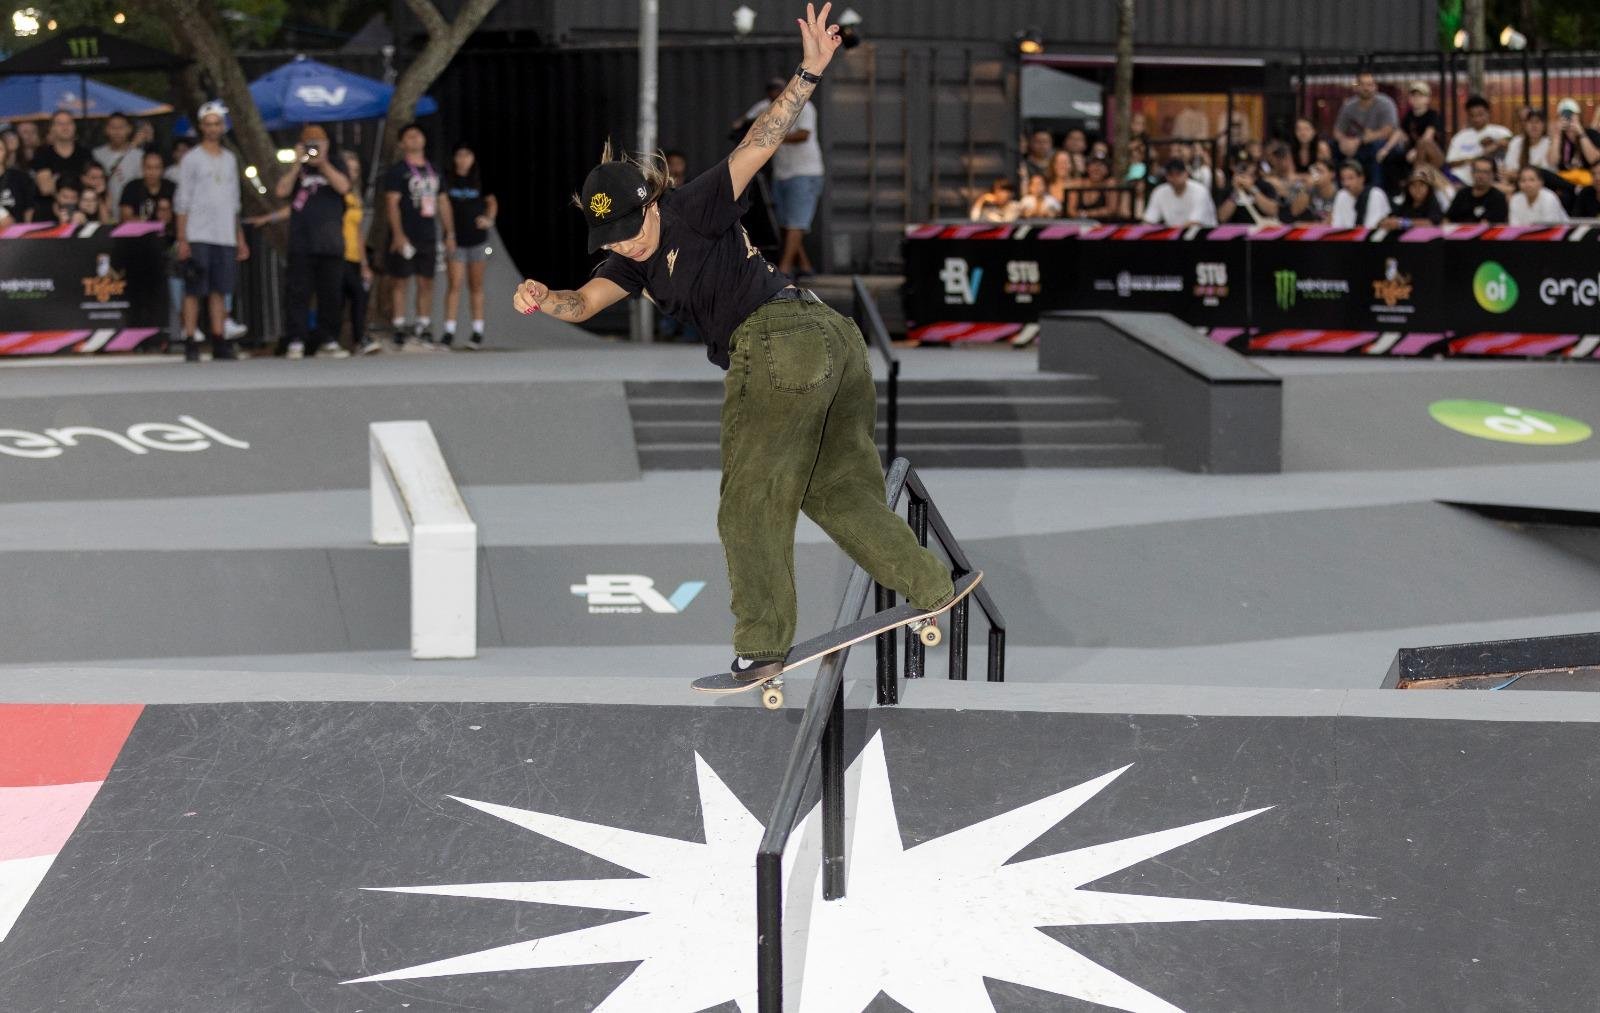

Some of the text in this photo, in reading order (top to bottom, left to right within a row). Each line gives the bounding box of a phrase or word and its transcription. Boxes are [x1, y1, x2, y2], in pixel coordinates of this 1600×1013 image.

[1485, 271, 1507, 301] oi
[1483, 405, 1557, 436] oi
[0, 415, 250, 459] enel
